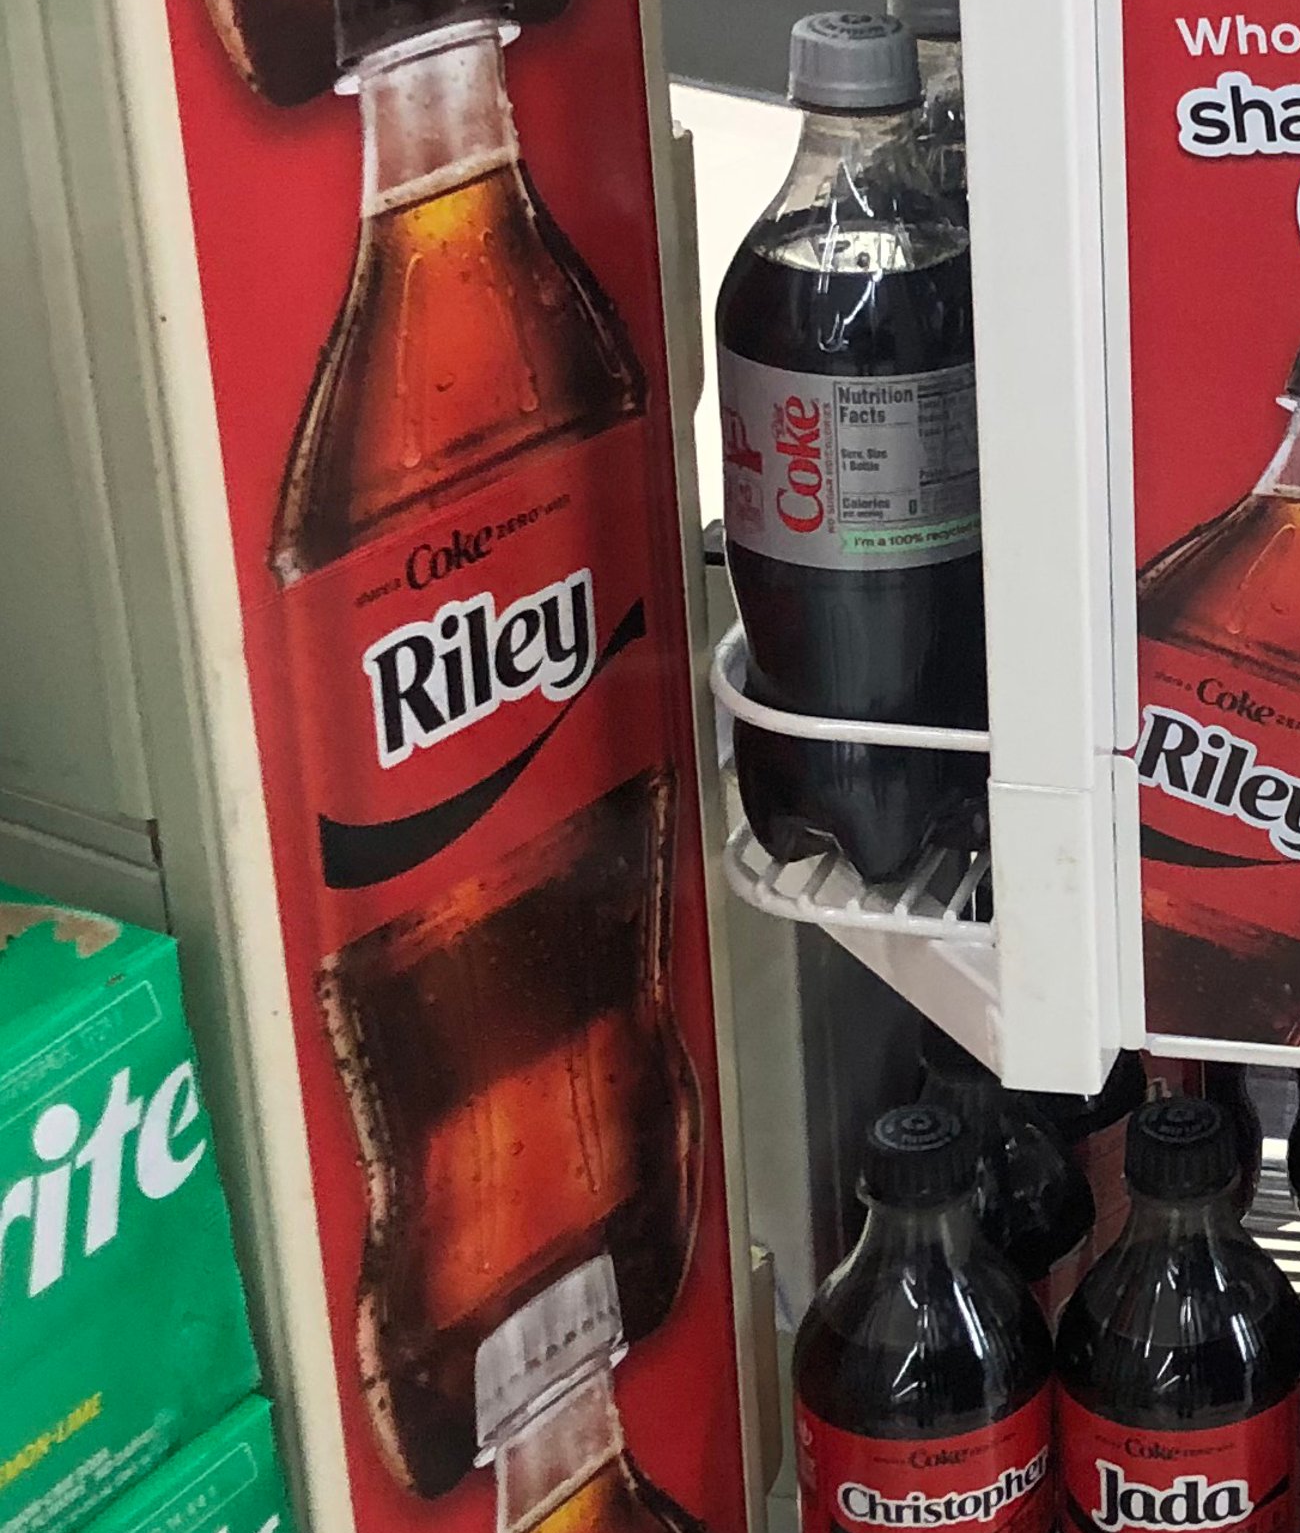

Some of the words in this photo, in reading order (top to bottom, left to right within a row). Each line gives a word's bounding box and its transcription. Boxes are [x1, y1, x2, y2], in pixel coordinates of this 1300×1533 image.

[838, 386, 914, 405] Nutrition
[839, 406, 887, 424] Facts
[776, 394, 824, 534] Coke
[405, 525, 494, 591] Coke
[363, 568, 596, 769] Riley
[1196, 677, 1276, 726] Coke
[837, 1444, 1050, 1529] Christopher
[1091, 1458, 1255, 1533] Jada
